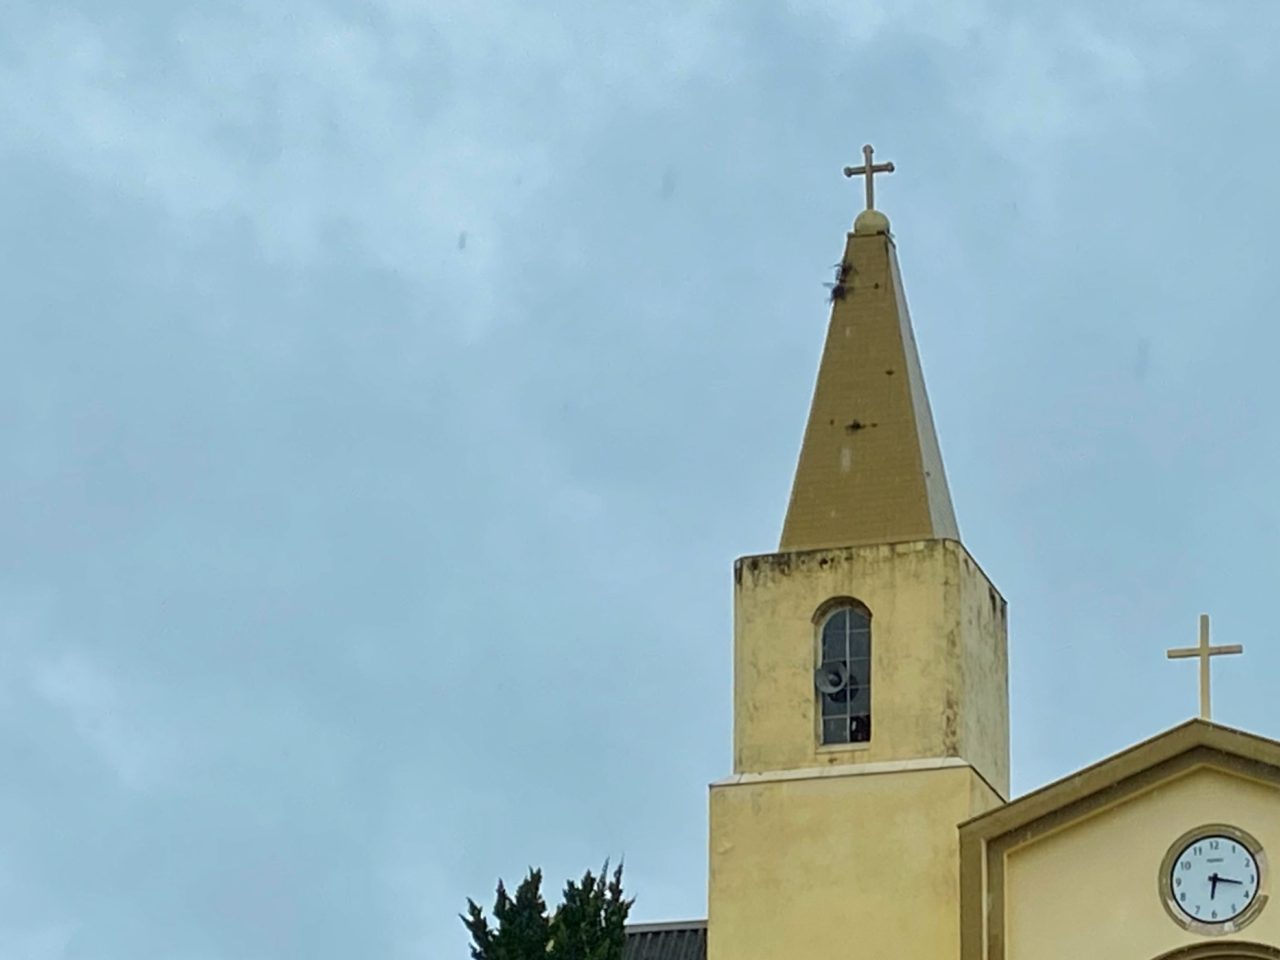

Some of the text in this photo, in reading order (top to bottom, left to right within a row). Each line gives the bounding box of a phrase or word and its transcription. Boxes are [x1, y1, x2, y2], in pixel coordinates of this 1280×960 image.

[1209, 840, 1219, 850] 12
[1194, 846, 1202, 856] 11
[1180, 861, 1191, 870] 10
